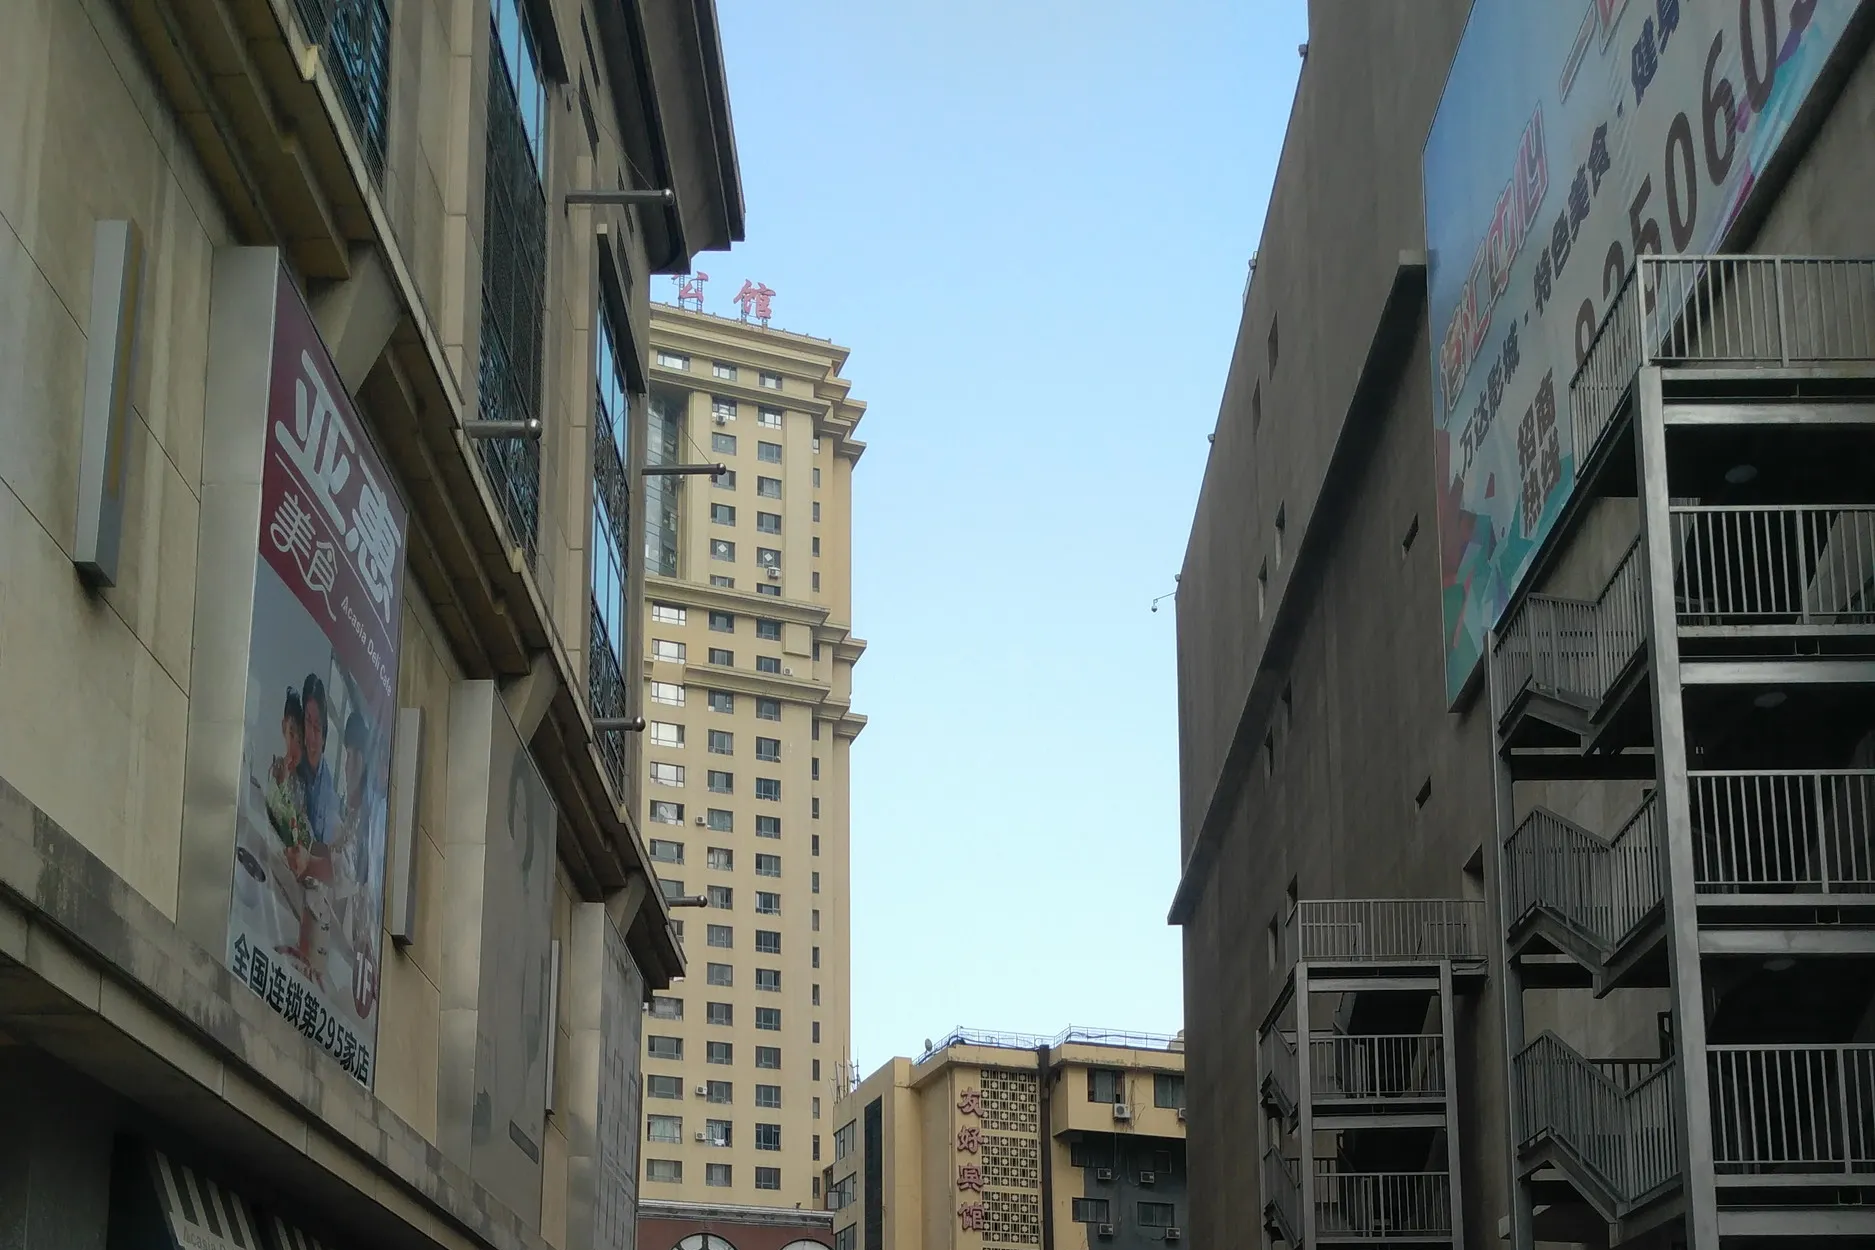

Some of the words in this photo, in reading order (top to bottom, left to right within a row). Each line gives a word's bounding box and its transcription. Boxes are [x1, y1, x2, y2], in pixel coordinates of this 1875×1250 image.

[1517, 367, 1556, 481] 招商
[1521, 426, 1561, 537] 热线
[275, 349, 401, 623] 亚惠
[270, 491, 337, 621] 美食
[341, 596, 366, 645] Acasia
[367, 639, 380, 671] Deli
[233, 933, 370, 1085] 全国连锁第295家店
[356, 952, 374, 1006] 1F
[957, 1087, 985, 1232] 友好宾馆
